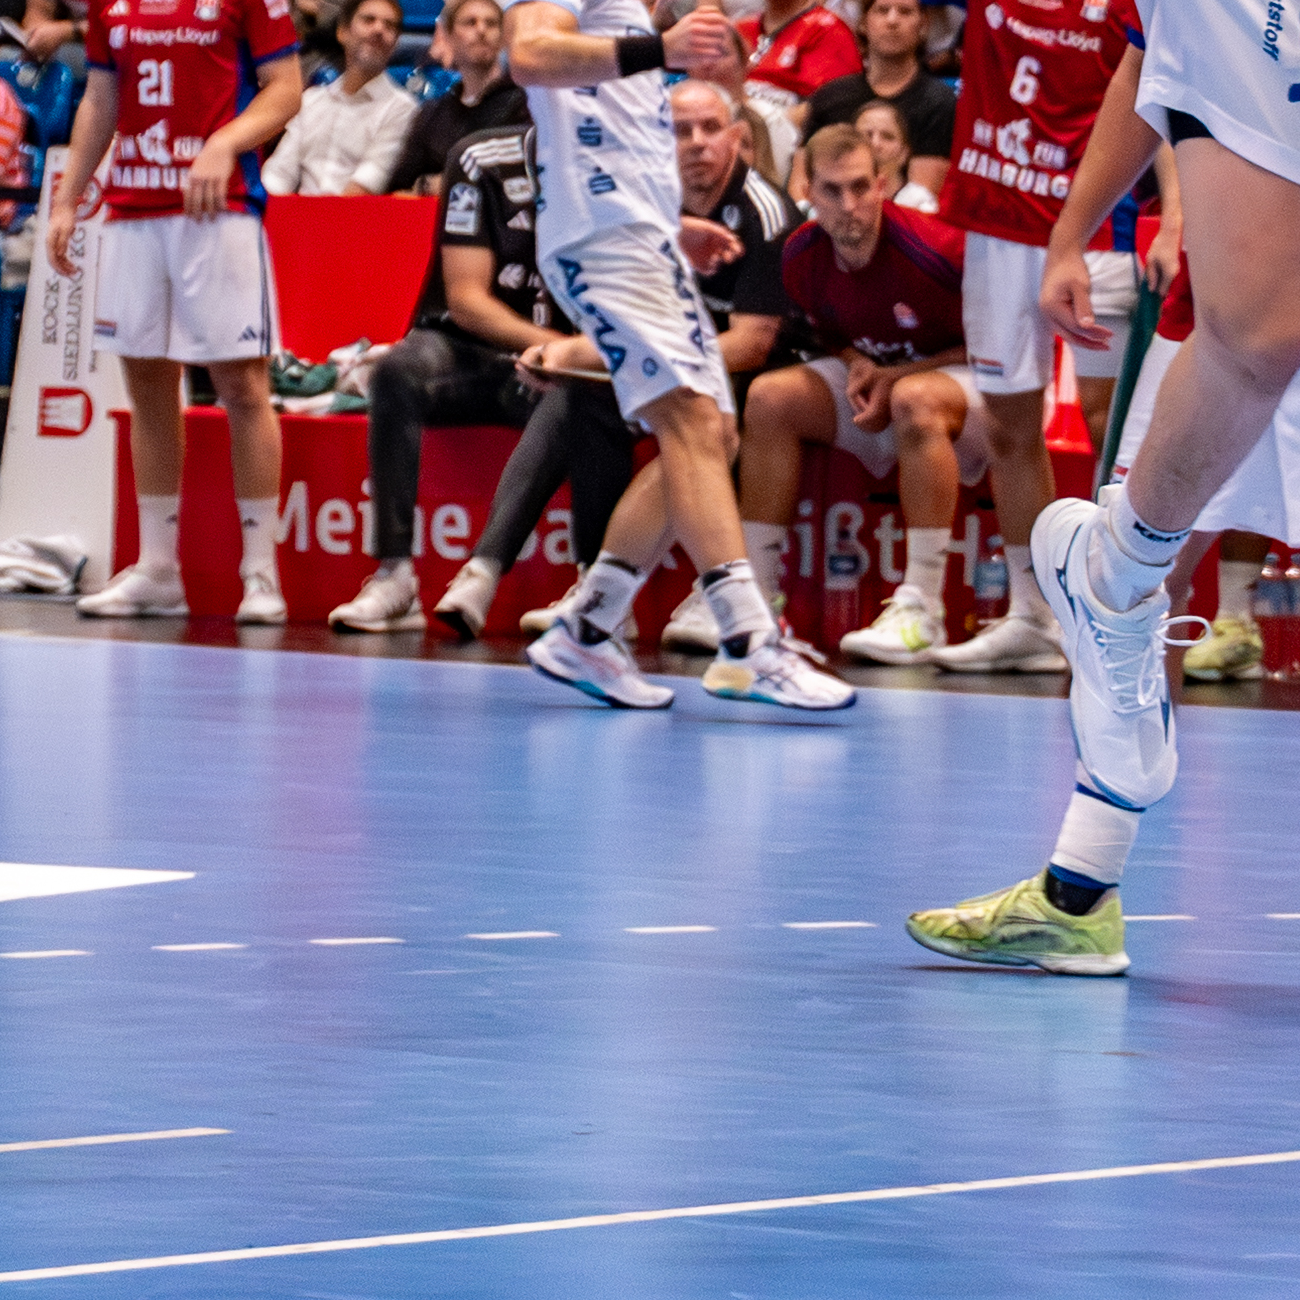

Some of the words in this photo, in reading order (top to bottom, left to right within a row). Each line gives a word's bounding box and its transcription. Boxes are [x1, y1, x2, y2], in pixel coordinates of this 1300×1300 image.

[136, 58, 174, 107] 21
[1009, 54, 1042, 106] 6
[274, 479, 472, 561] Meie
